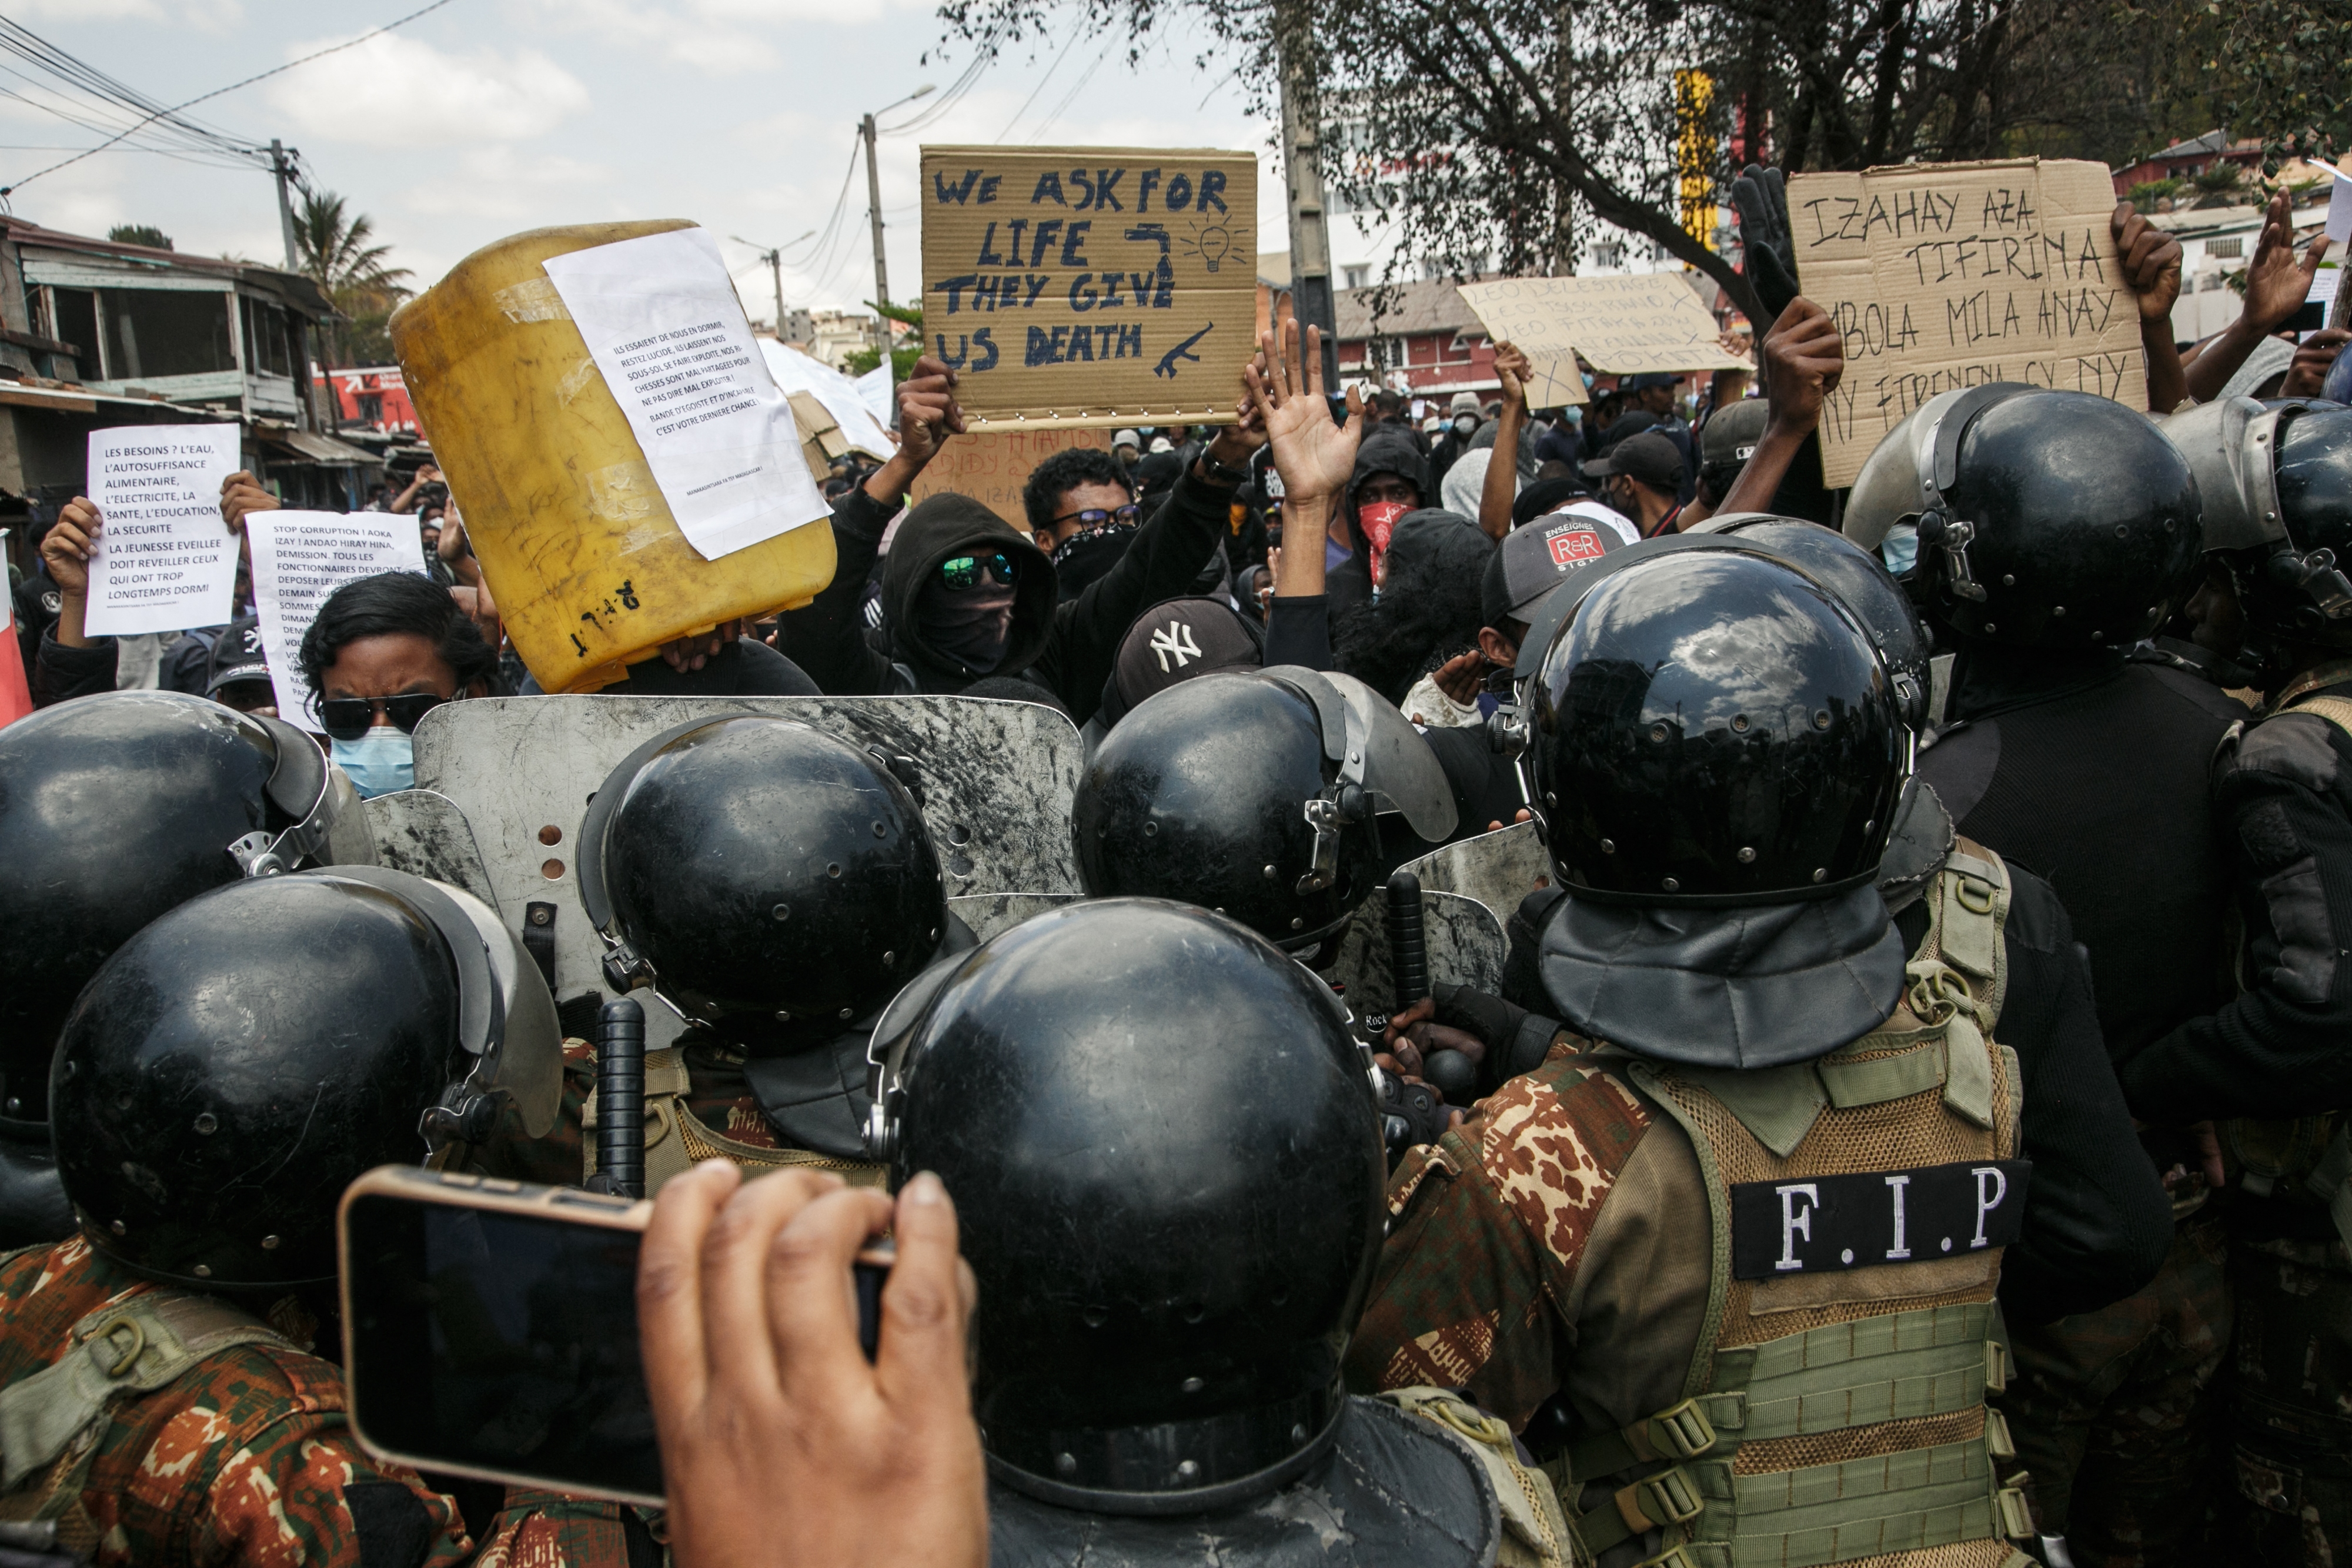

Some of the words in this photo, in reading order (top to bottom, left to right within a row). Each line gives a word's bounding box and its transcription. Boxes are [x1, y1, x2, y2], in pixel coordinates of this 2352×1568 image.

[934, 169, 1002, 206] WE
[1030, 168, 1126, 212] ASK
[1137, 168, 1228, 215] FOR
[1803, 189, 1959, 247] IZAHAY
[1983, 189, 2036, 231] AZA
[977, 218, 1092, 268] LIFE
[1905, 228, 2104, 285] TIFIRINA
[934, 273, 1050, 316] THEY
[1069, 270, 1176, 312] GIVE
[1469, 281, 1520, 305] LEO
[1523, 277, 1668, 297] DELESTAGE,
[1484, 303, 1536, 322] LEO
[1947, 289, 2020, 347] MILA
[2038, 287, 2122, 339] ANAY
[613, 346, 625, 355] ILS
[626, 336, 658, 352] ESSAIENT
[659, 333, 670, 343] DE
[669, 329, 689, 340] NOUS
[688, 326, 698, 335] EN
[697, 321, 726, 333] DORMIR,
[1501, 320, 1546, 342] LEO
[620, 355, 647, 368] RESTEZ
[647, 346, 675, 360] LUCIDE,
[674, 344, 684, 352] ILS
[683, 337, 713, 351] LAISSENT
[712, 335, 726, 344] NOS
[935, 327, 1000, 373] US
[1024, 322, 1142, 367] DEATH
[627, 364, 664, 381] SOUS-SOL
[663, 361, 674, 370] SE
[673, 356, 692, 367] FAIRE
[692, 349, 722, 363] EXPLOITE,
[721, 346, 735, 356] NOS
[734, 345, 743, 353] RI-
[634, 378, 666, 394] CHESSES
[665, 372, 685, 385] SONT
[685, 368, 701, 379] MAL
[701, 360, 734, 375] PARTAGEES
[734, 356, 751, 367] POUR
[642, 397, 653, 407] NE
[653, 394, 667, 404] PAS
[667, 388, 684, 400] DIRE
[683, 383, 701, 393] MAL
[701, 376, 731, 389] EXPLOITER
[1822, 379, 1857, 446] NY
[2077, 352, 2126, 400] NY
[649, 409, 676, 423] BANDE
[675, 398, 710, 414] D'EGOISTE
[709, 395, 719, 404] ET
[719, 387, 756, 402] D'INCAPABLE
[656, 423, 676, 436] C'EST
[676, 416, 700, 430] VOTRE
[699, 407, 731, 422] DERNIERE
[730, 399, 757, 413] CHANCE
[105, 449, 121, 458] LES
[124, 446, 169, 456] BESOINS
[172, 445, 177, 454] ?
[181, 445, 215, 454] L'EAU,
[105, 460, 206, 473] L'AUTOSUFFISANCE
[105, 477, 180, 489] ALIMENTAIRE,
[106, 492, 180, 504] L'ELECTRICITE,
[183, 492, 196, 500] LA
[106, 510, 143, 520] SANTE,
[146, 506, 220, 518] L'EDUCATION,
[108, 527, 121, 536] LA
[123, 524, 172, 535] SECURITE
[300, 526, 359, 536] CORRUPTION
[368, 529, 393, 539] AOKA
[1545, 521, 1593, 539] ENSEIGNES
[109, 544, 122, 554] LA
[125, 542, 175, 553] JEUNESSE
[178, 539, 222, 550] EVEILLEE
[275, 537, 295, 546] IZAY
[303, 539, 338, 547] ANDAO
[340, 540, 368, 548] HIRAY
[369, 540, 395, 550] HINA,
[1556, 535, 1599, 560] R&R
[110, 560, 136, 570] DOIT
[138, 557, 190, 568] REVEILLER
[192, 554, 219, 564] CEUX
[276, 550, 330, 560] DEMISSION.
[333, 552, 357, 561] TOUS
[359, 553, 374, 561] LES
[277, 563, 356, 573] FONCTIONNAIRES
[109, 576, 129, 586] QUI
[132, 574, 154, 583] ONT
[157, 572, 183, 581] TROP
[278, 576, 319, 586] DEPOSER
[321, 577, 349, 586] LEURS
[108, 587, 172, 600] LONGTEMPS
[174, 584, 209, 595] DORMI
[279, 589, 315, 598] DEMAIN
[279, 602, 320, 611] SOMMES
[1150, 620, 1202, 673] NY
[1365, 1014, 1387, 1026] Rock
